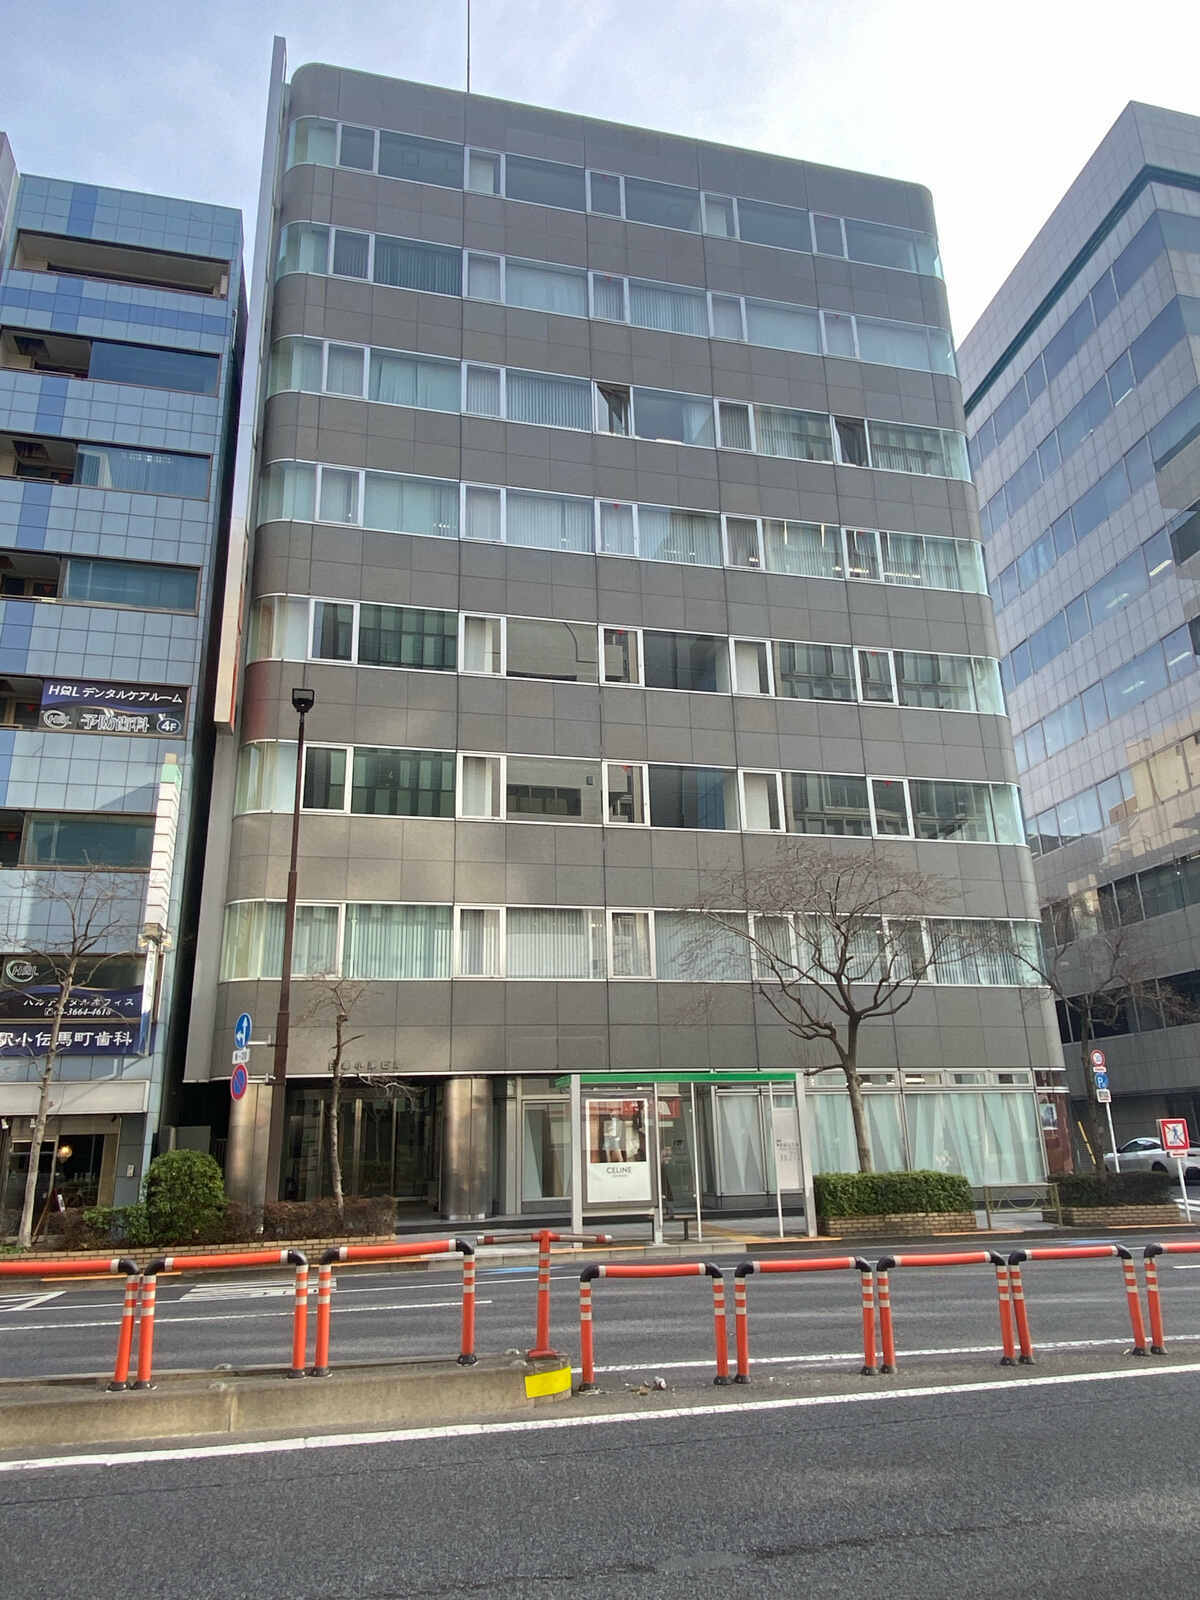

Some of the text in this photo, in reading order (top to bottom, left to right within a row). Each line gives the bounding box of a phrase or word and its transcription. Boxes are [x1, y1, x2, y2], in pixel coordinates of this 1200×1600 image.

[82, 687, 183, 704] デンタルケアルーム
[161, 720, 178, 732] 4F
